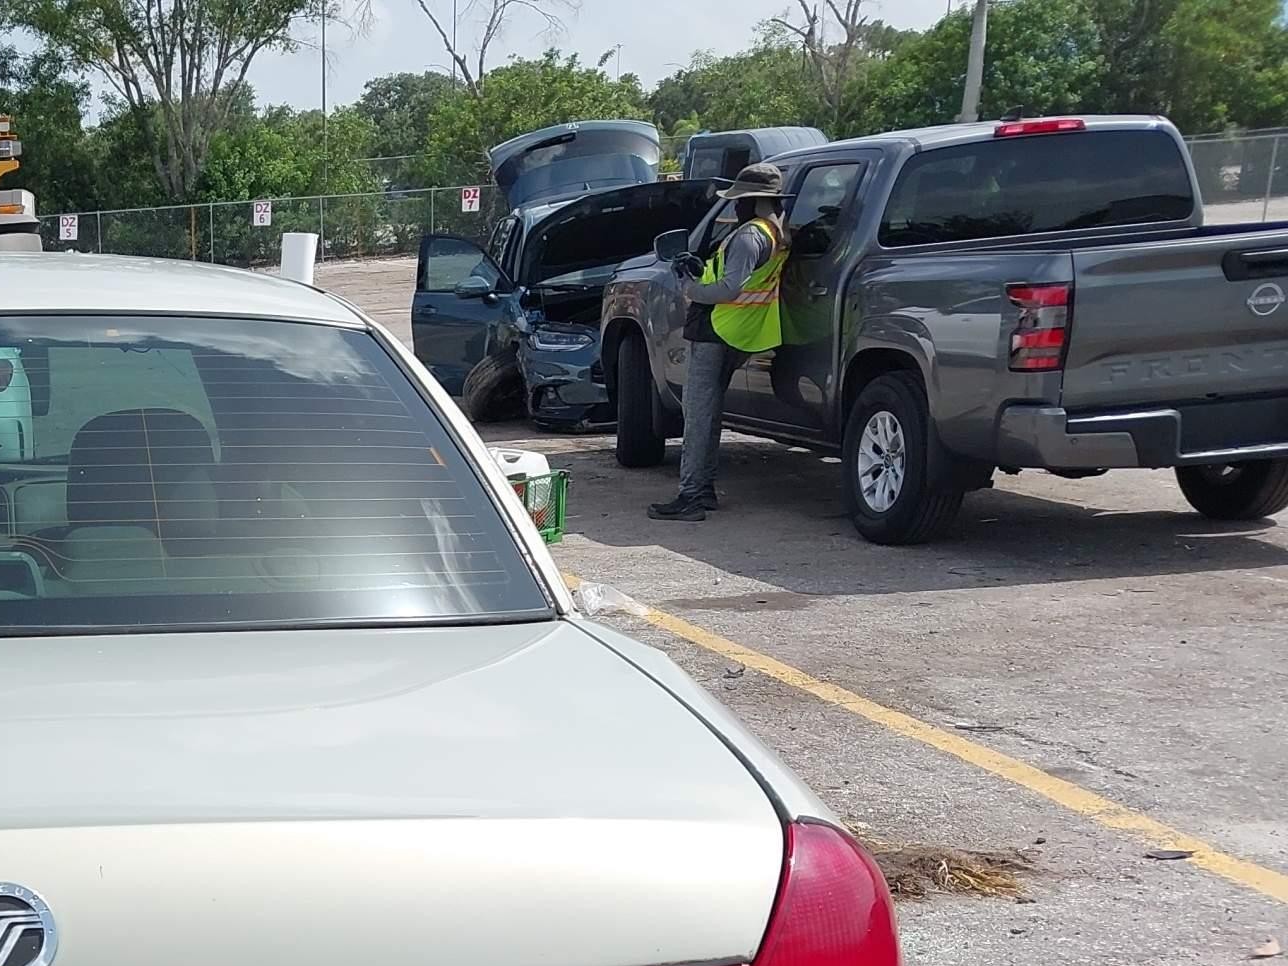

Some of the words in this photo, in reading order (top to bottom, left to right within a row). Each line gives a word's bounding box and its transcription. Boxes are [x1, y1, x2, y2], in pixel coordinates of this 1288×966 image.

[463, 189, 479, 199] DZ
[255, 203, 270, 213] DZ
[467, 200, 474, 210] 7
[62, 217, 76, 227] DZ
[259, 214, 265, 223] 6
[66, 228, 72, 238] 5
